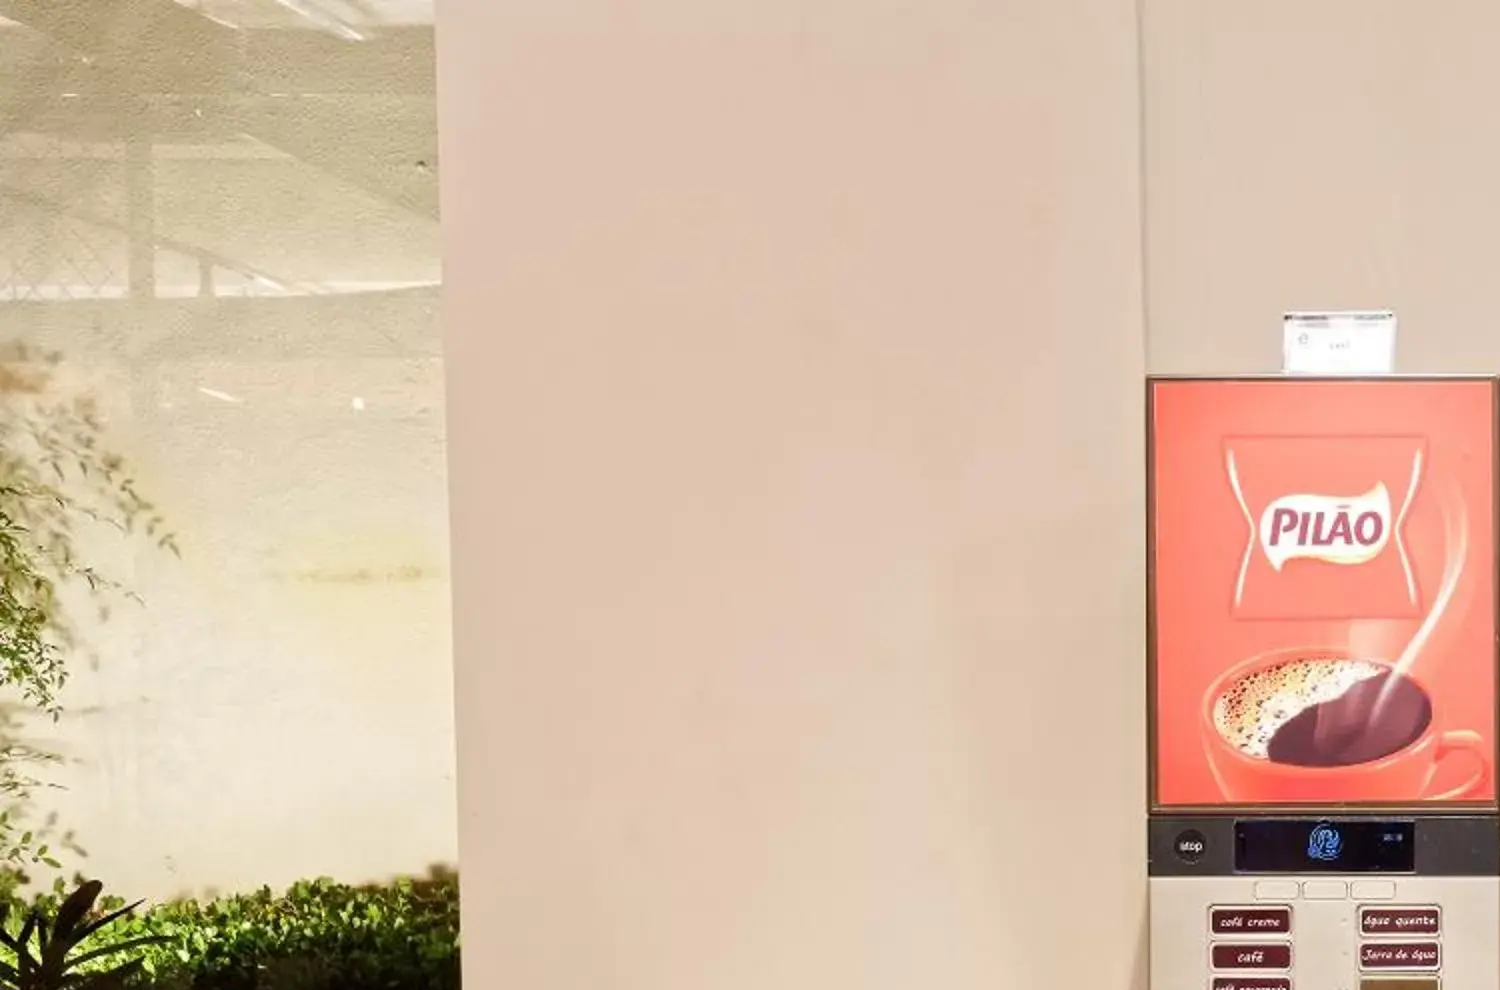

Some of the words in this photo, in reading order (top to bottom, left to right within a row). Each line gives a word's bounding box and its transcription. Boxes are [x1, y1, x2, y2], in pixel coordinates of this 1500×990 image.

[1269, 504, 1383, 546] PILÃO
[1180, 841, 1203, 853] stop
[1220, 916, 1243, 927] café
[1247, 918, 1280, 927] creme
[1395, 915, 1436, 928] quente
[1237, 950, 1264, 963] café
